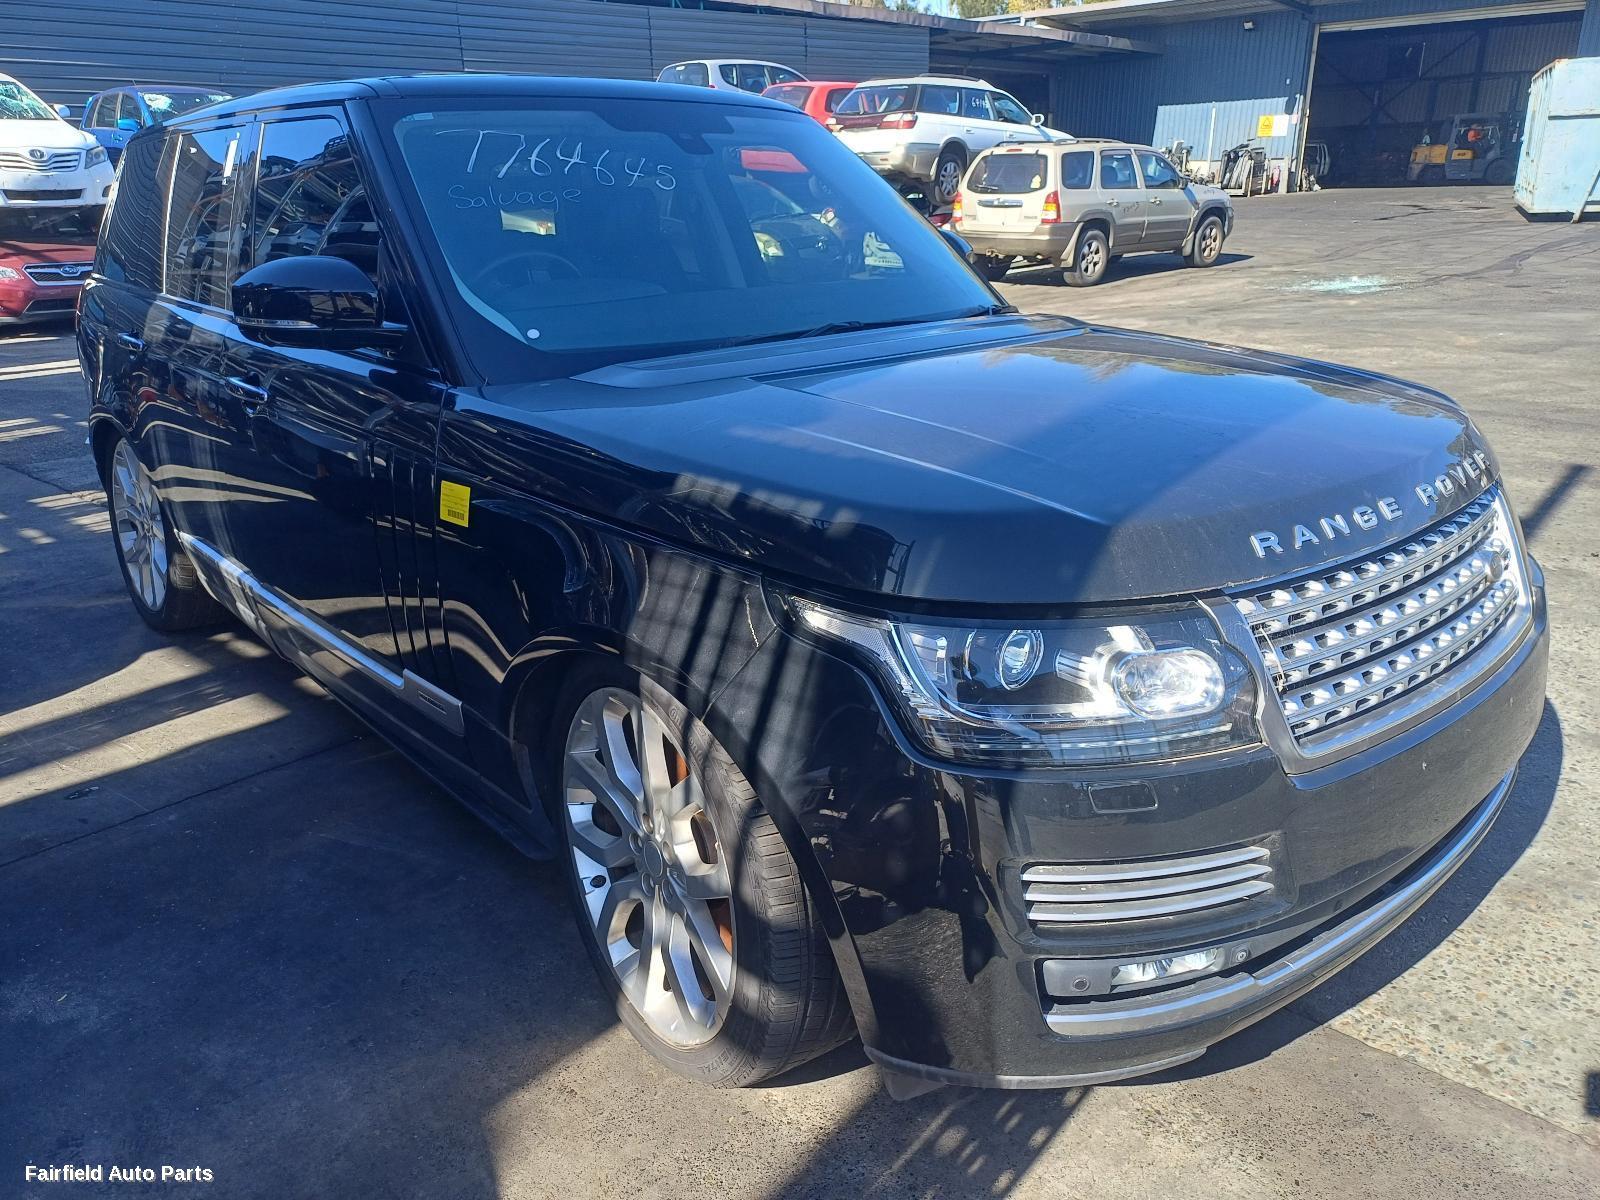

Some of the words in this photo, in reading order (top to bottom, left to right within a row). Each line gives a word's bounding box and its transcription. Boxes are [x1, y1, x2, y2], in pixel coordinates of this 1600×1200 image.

[448, 185, 583, 212] Salvage
[1250, 496, 1403, 558] RANGE
[1415, 449, 1490, 506] ROVER
